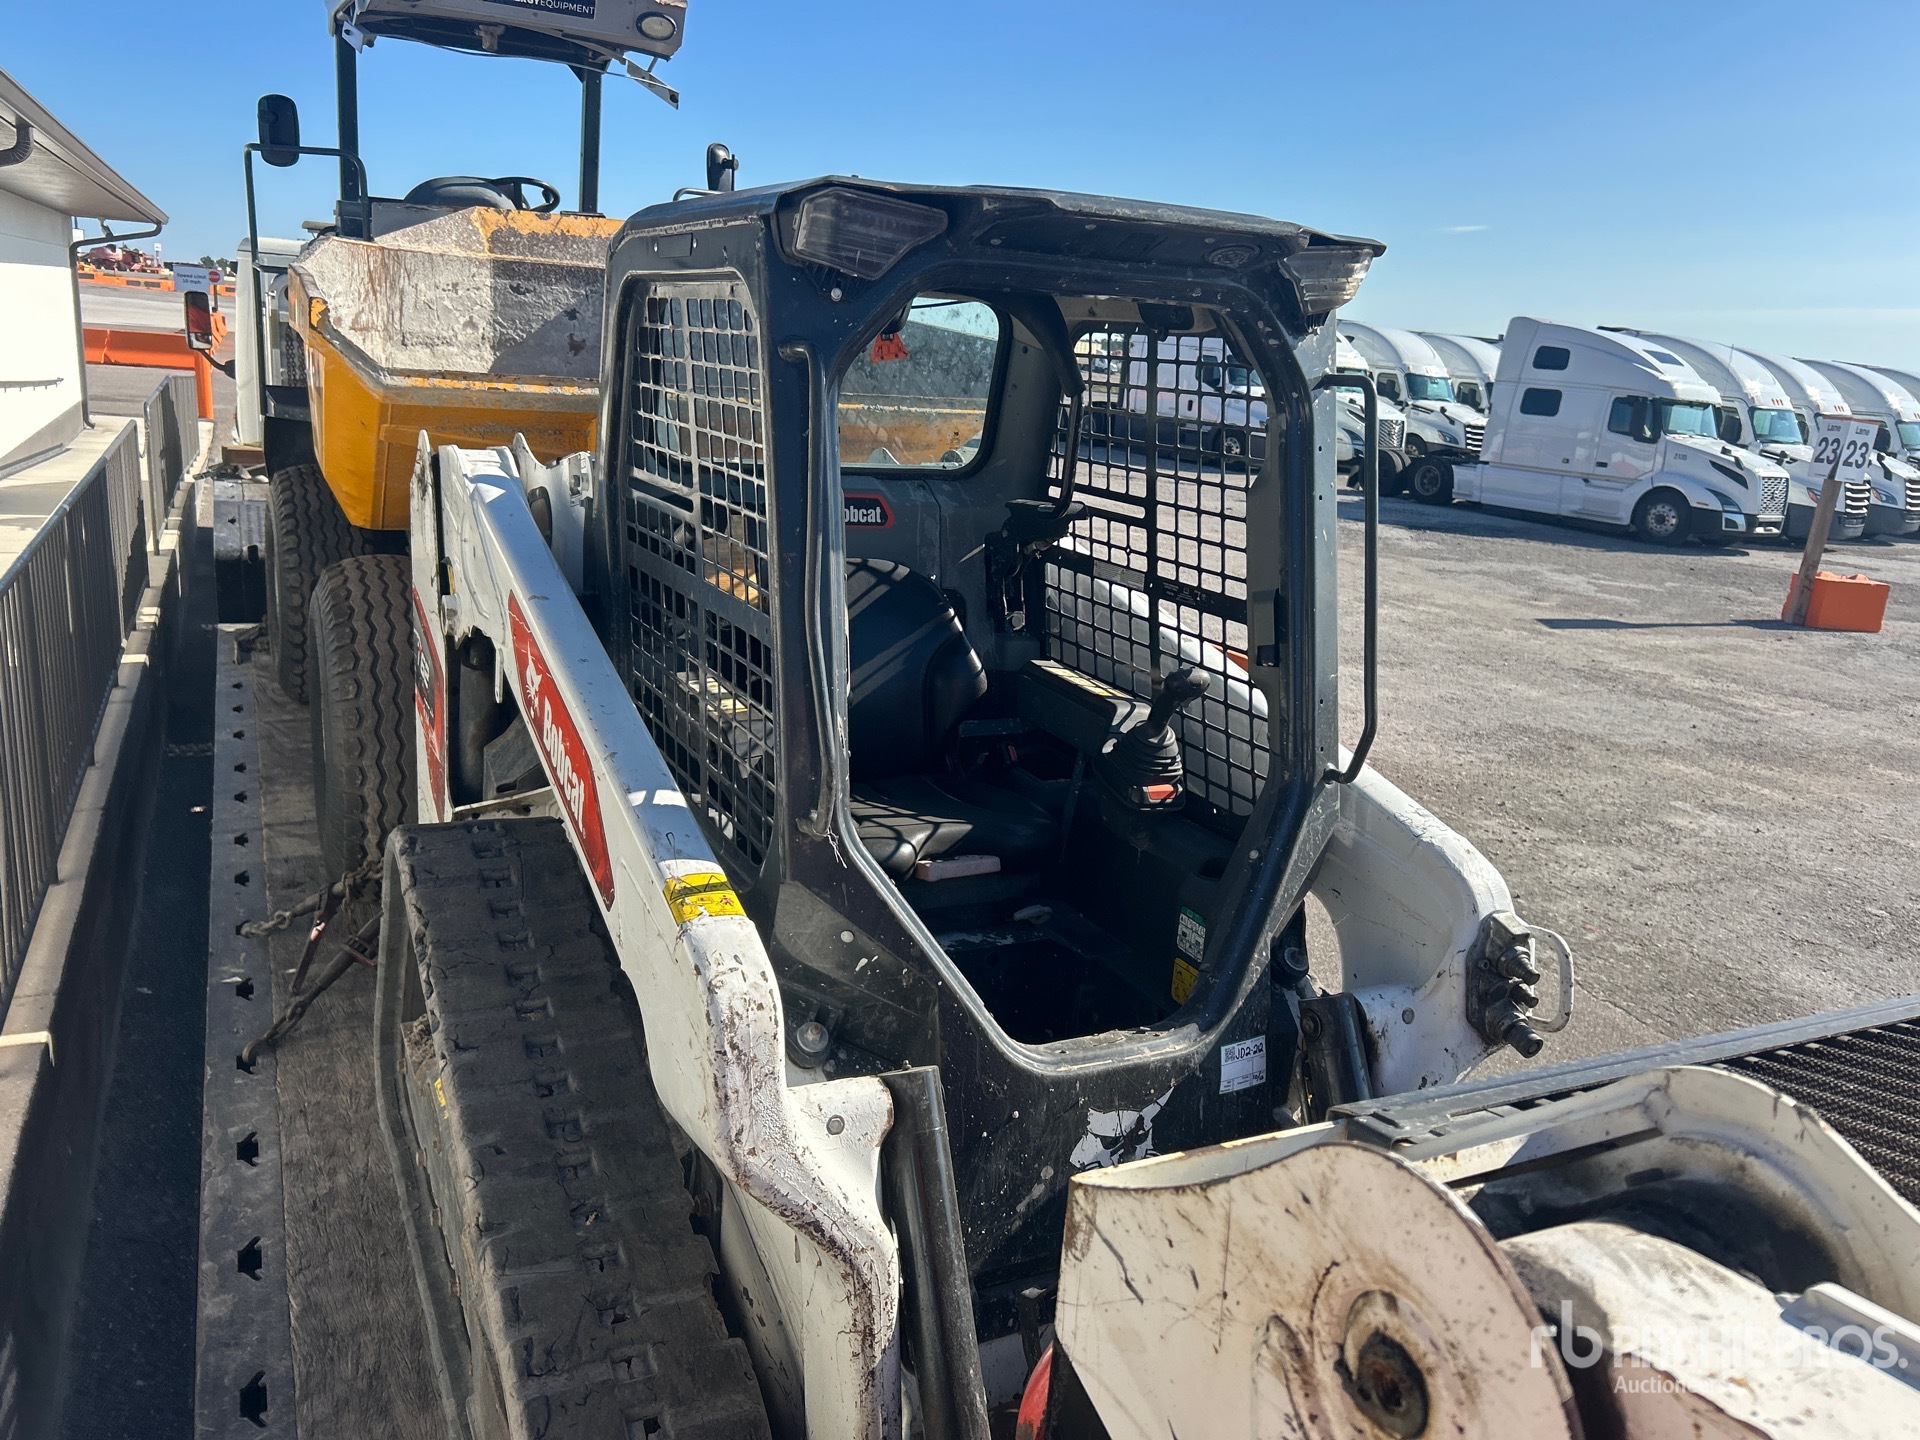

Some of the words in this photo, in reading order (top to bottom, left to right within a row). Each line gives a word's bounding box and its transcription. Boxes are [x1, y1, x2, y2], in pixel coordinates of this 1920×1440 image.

[1827, 423, 1841, 432] Lane
[1855, 426, 1870, 436] Lane
[1814, 436, 1841, 465] 23
[1842, 440, 1869, 469] 23
[844, 505, 882, 523] obcat
[543, 695, 585, 833] Bobcat
